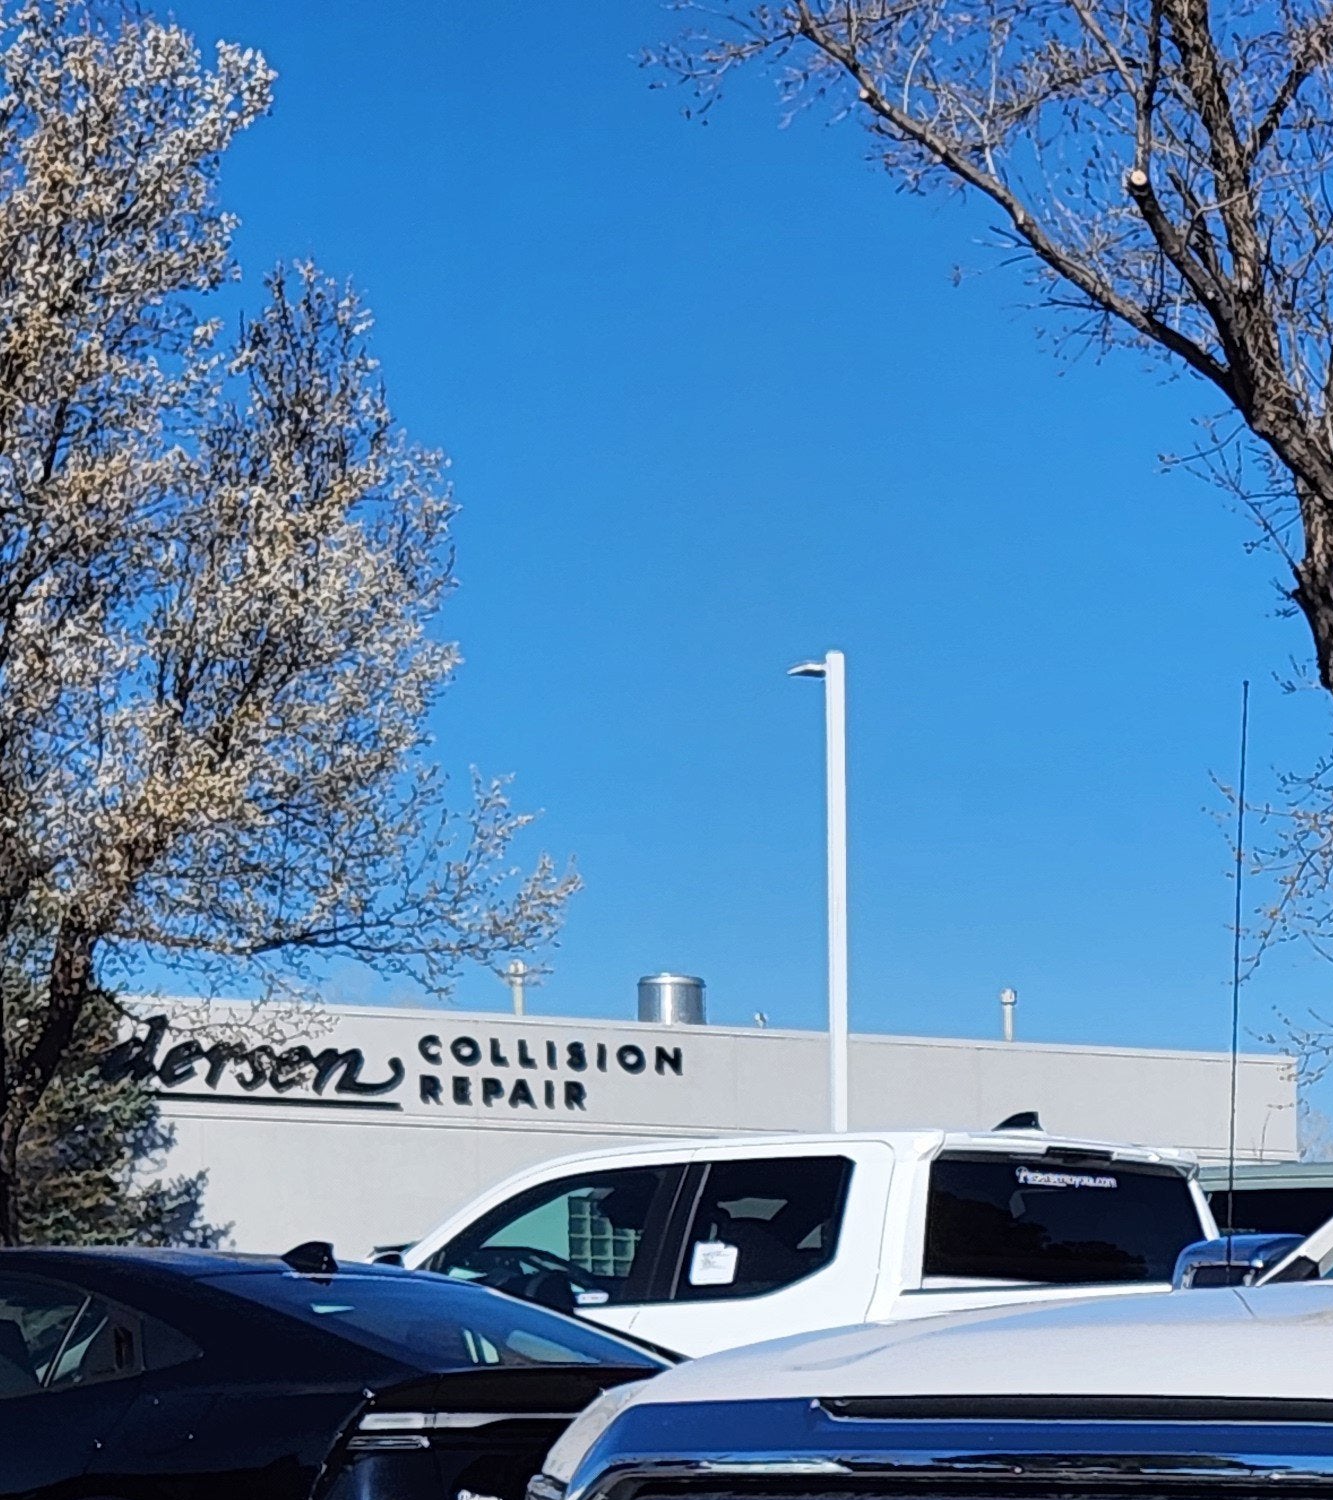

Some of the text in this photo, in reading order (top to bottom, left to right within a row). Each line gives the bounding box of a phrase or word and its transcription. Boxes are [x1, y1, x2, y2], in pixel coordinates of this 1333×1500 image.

[100, 1014, 404, 1097] dersen
[418, 1034, 683, 1076] COLLISION
[419, 1074, 588, 1111] REPAIR
